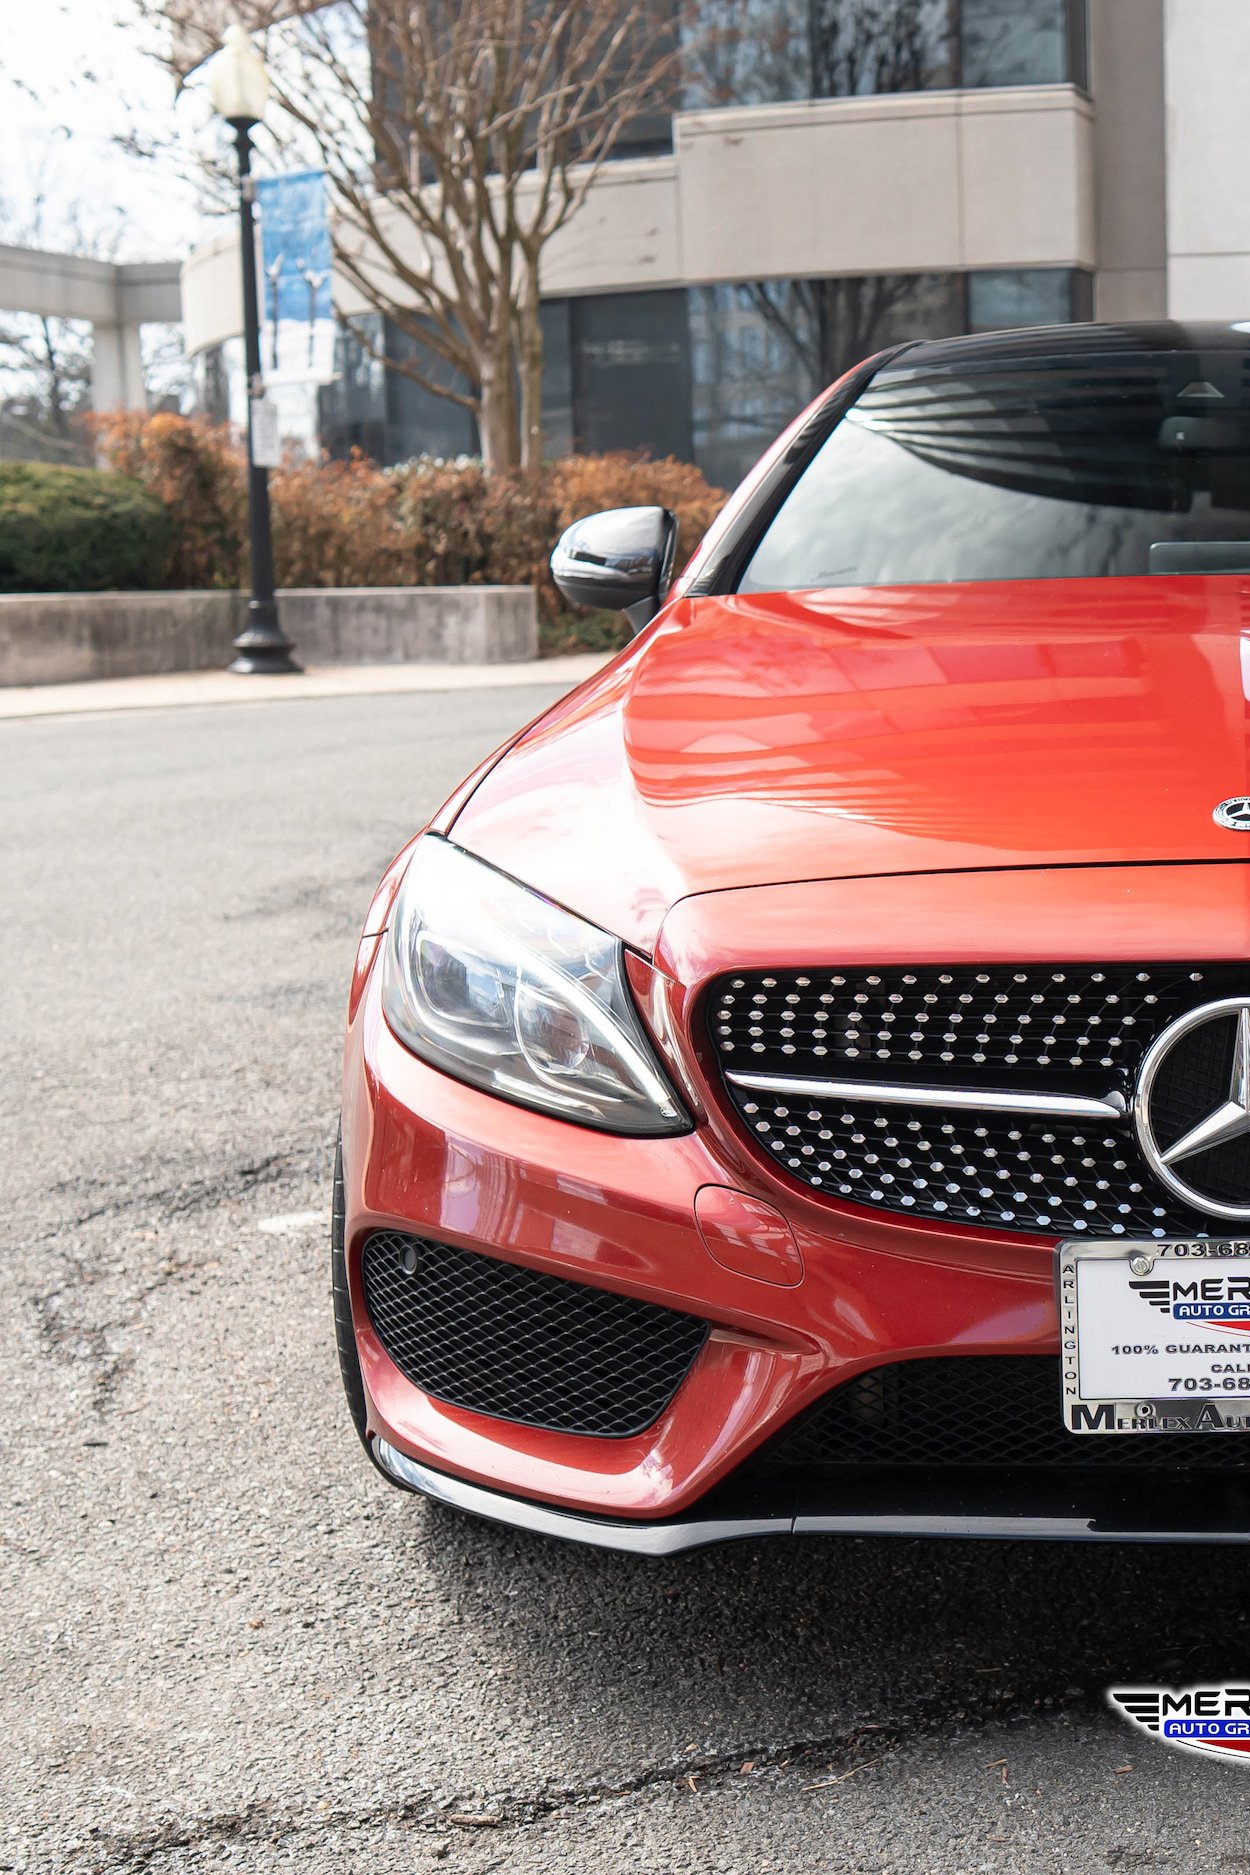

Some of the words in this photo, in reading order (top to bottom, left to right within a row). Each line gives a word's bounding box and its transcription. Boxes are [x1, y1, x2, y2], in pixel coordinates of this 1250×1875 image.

[1179, 1304, 1224, 1317] AUTO
[1062, 1264, 1077, 1395] ARLINGTON
[1111, 1345, 1159, 1355] 100%
